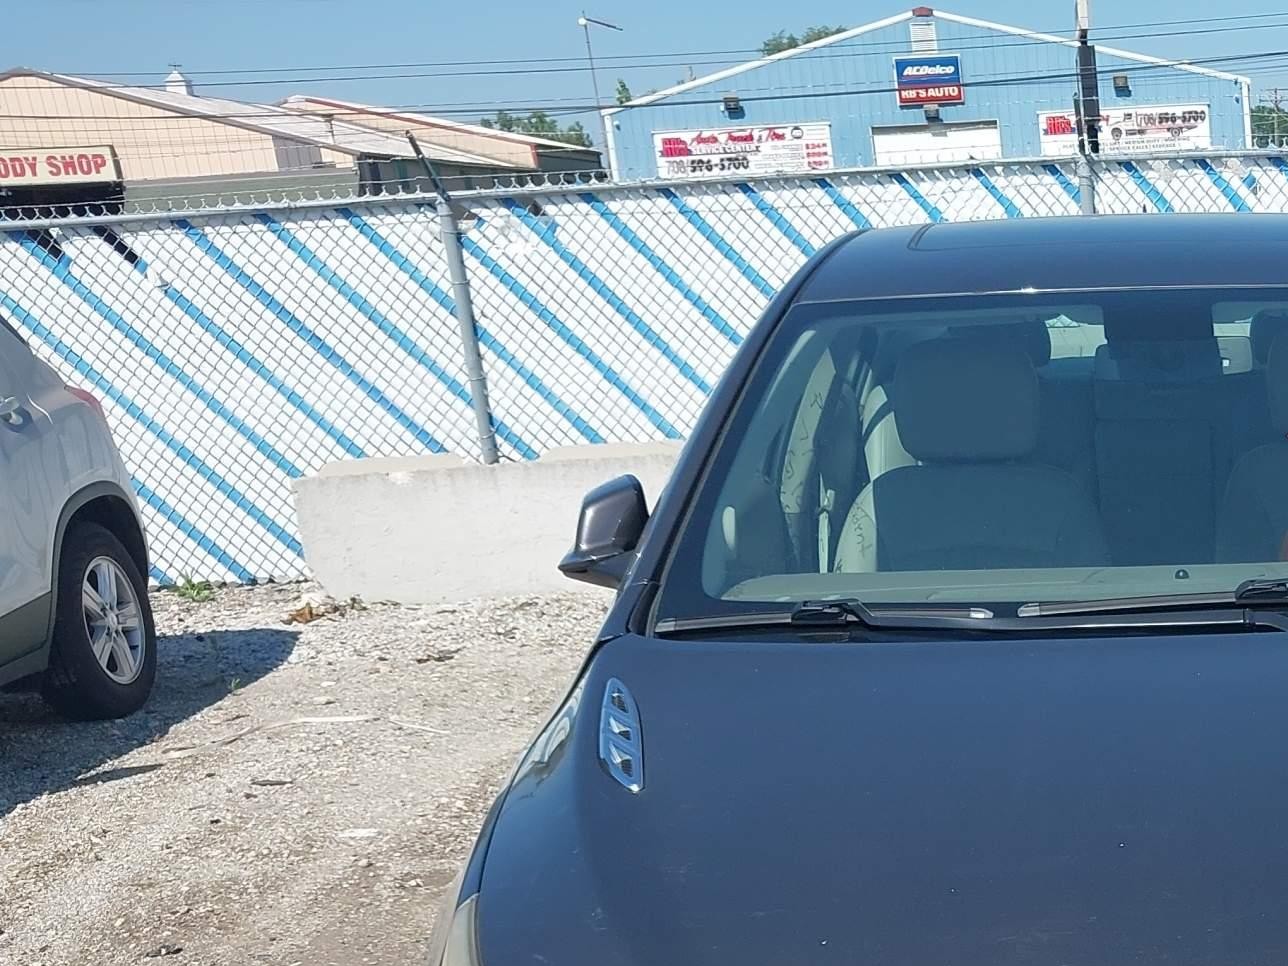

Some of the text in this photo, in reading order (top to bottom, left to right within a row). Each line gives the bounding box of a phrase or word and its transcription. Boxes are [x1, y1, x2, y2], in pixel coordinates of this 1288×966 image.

[903, 65, 955, 76] ACDelco
[927, 86, 959, 97] AUTO
[45, 153, 107, 176] SHOP
